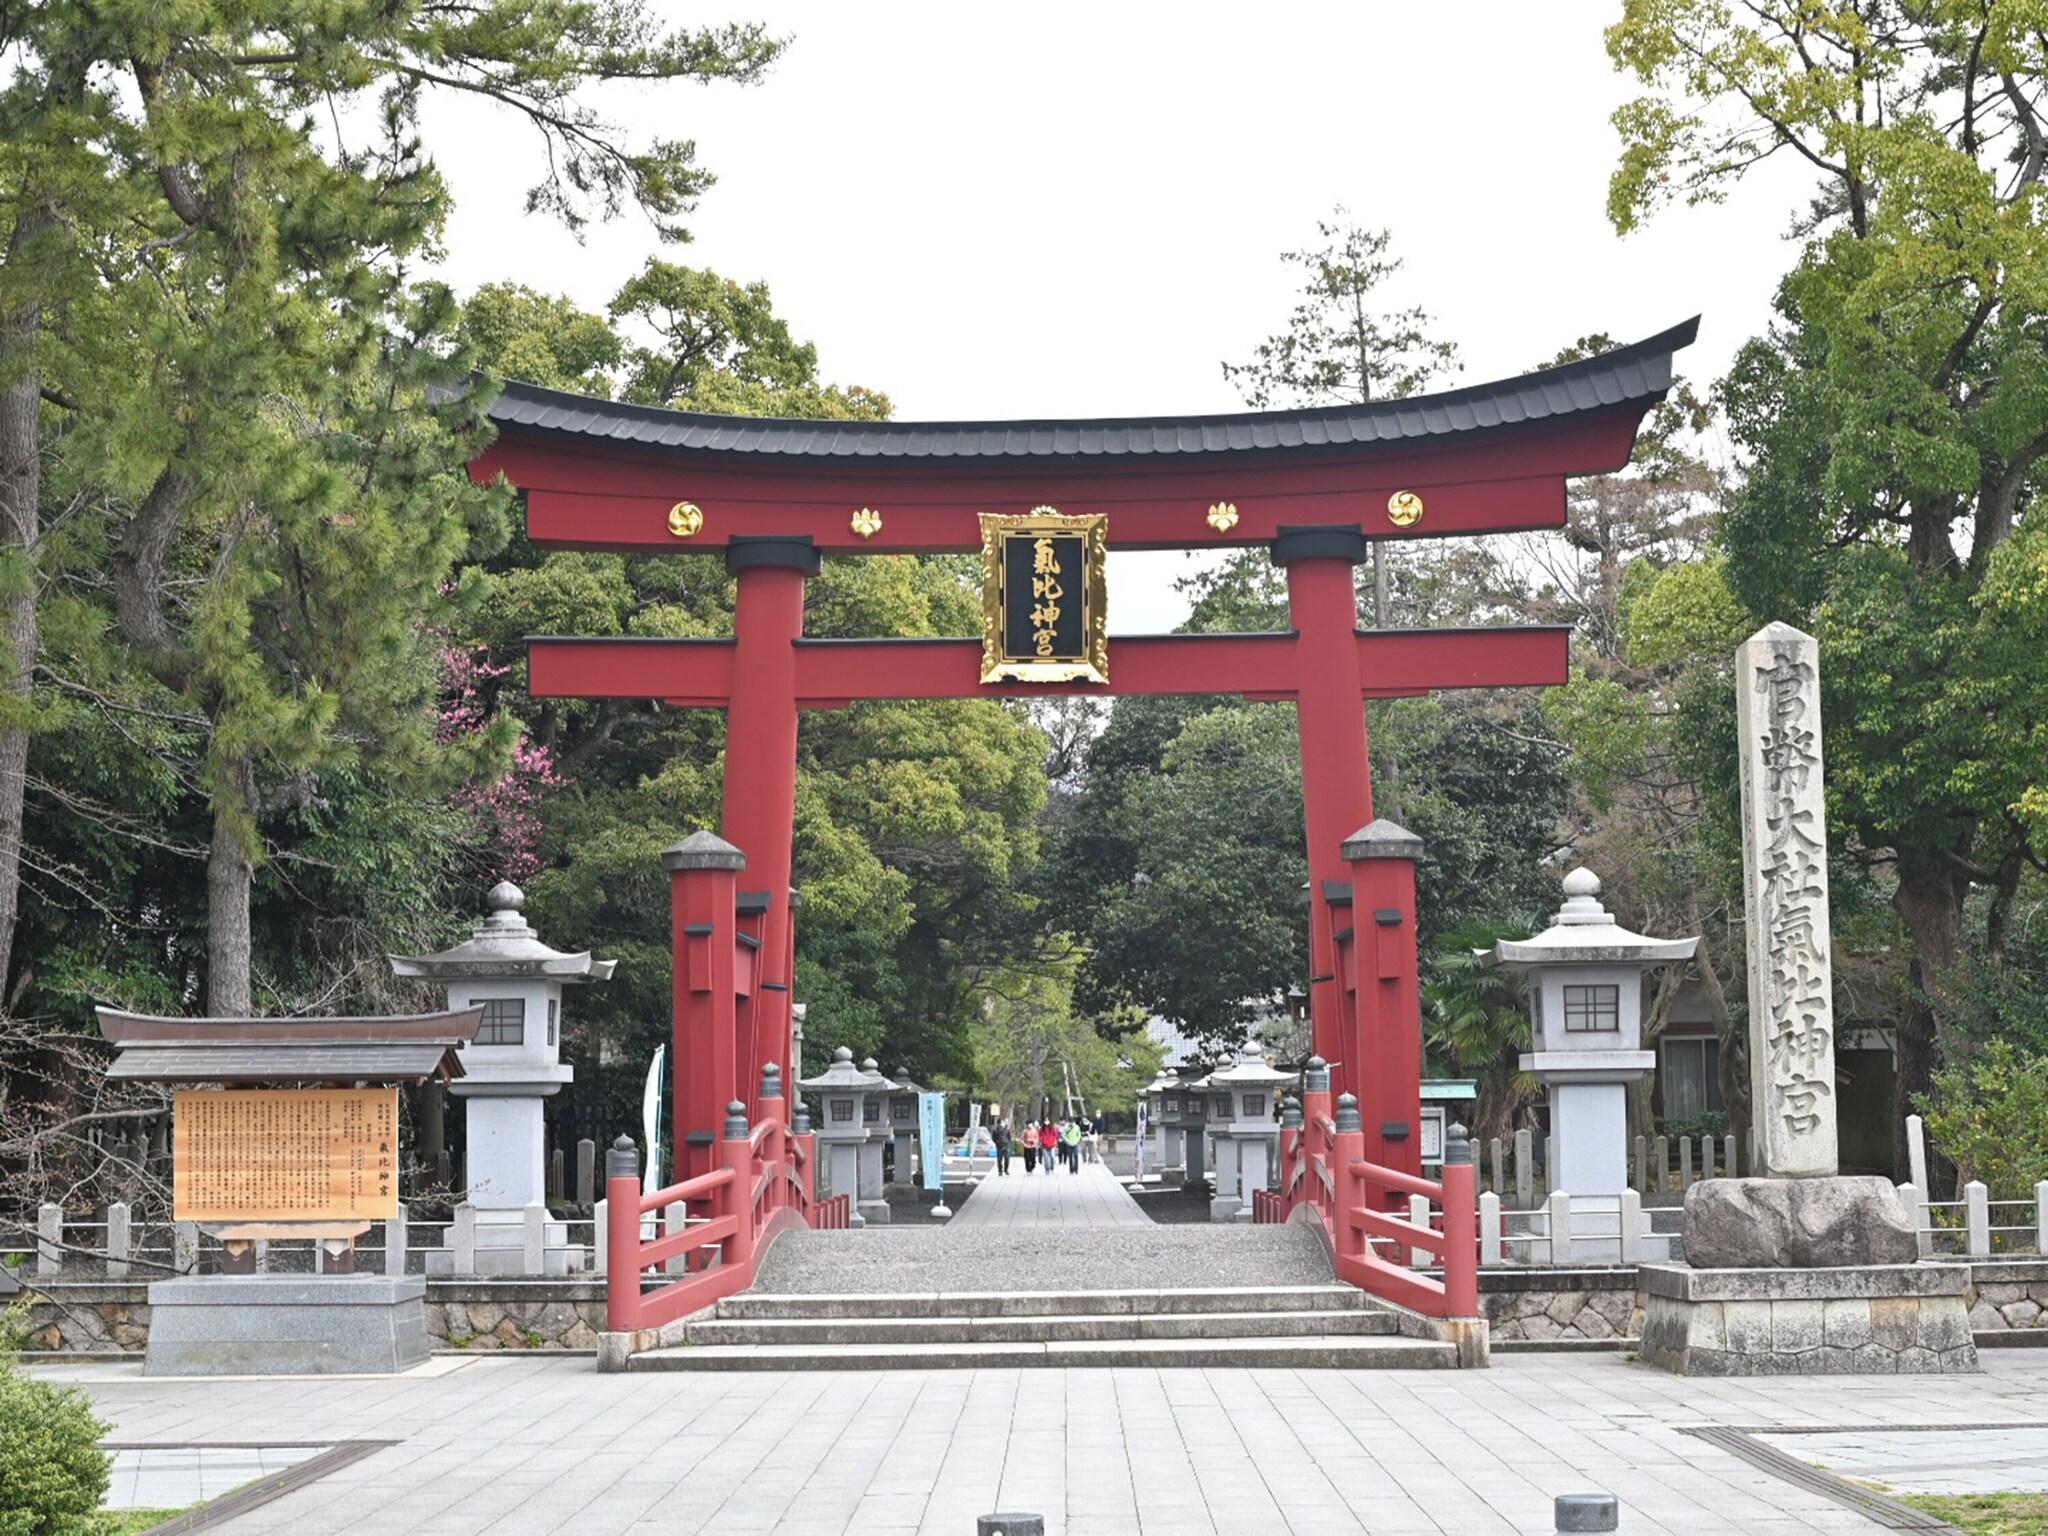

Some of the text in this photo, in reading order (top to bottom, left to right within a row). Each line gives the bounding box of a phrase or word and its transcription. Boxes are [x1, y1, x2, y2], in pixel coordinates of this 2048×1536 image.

[1029, 537, 1064, 657] 氣比神宮
[1754, 653, 1832, 1138] 官幣大社氣比神宮
